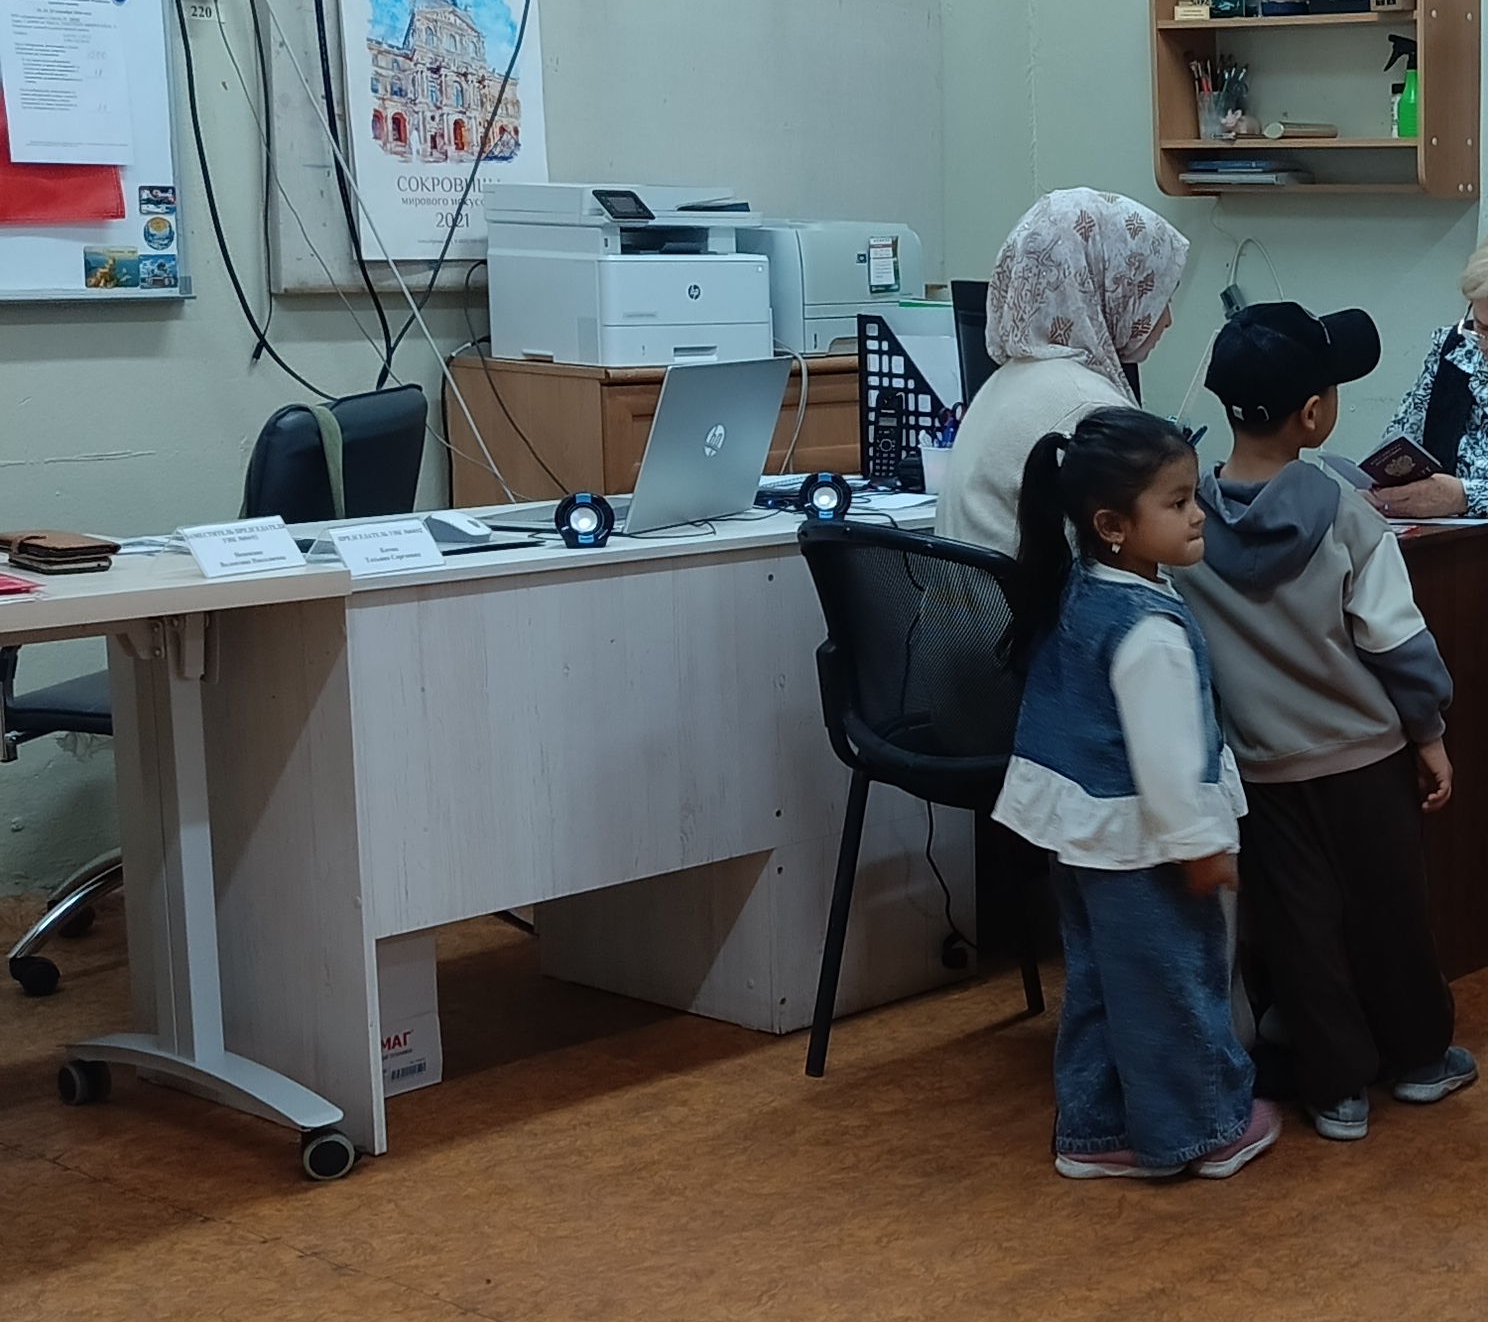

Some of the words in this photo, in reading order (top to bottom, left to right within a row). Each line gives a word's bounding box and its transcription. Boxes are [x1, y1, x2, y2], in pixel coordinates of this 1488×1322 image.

[190, 5, 212, 19] 220
[401, 196, 449, 209] мирового
[435, 212, 470, 229] 2021
